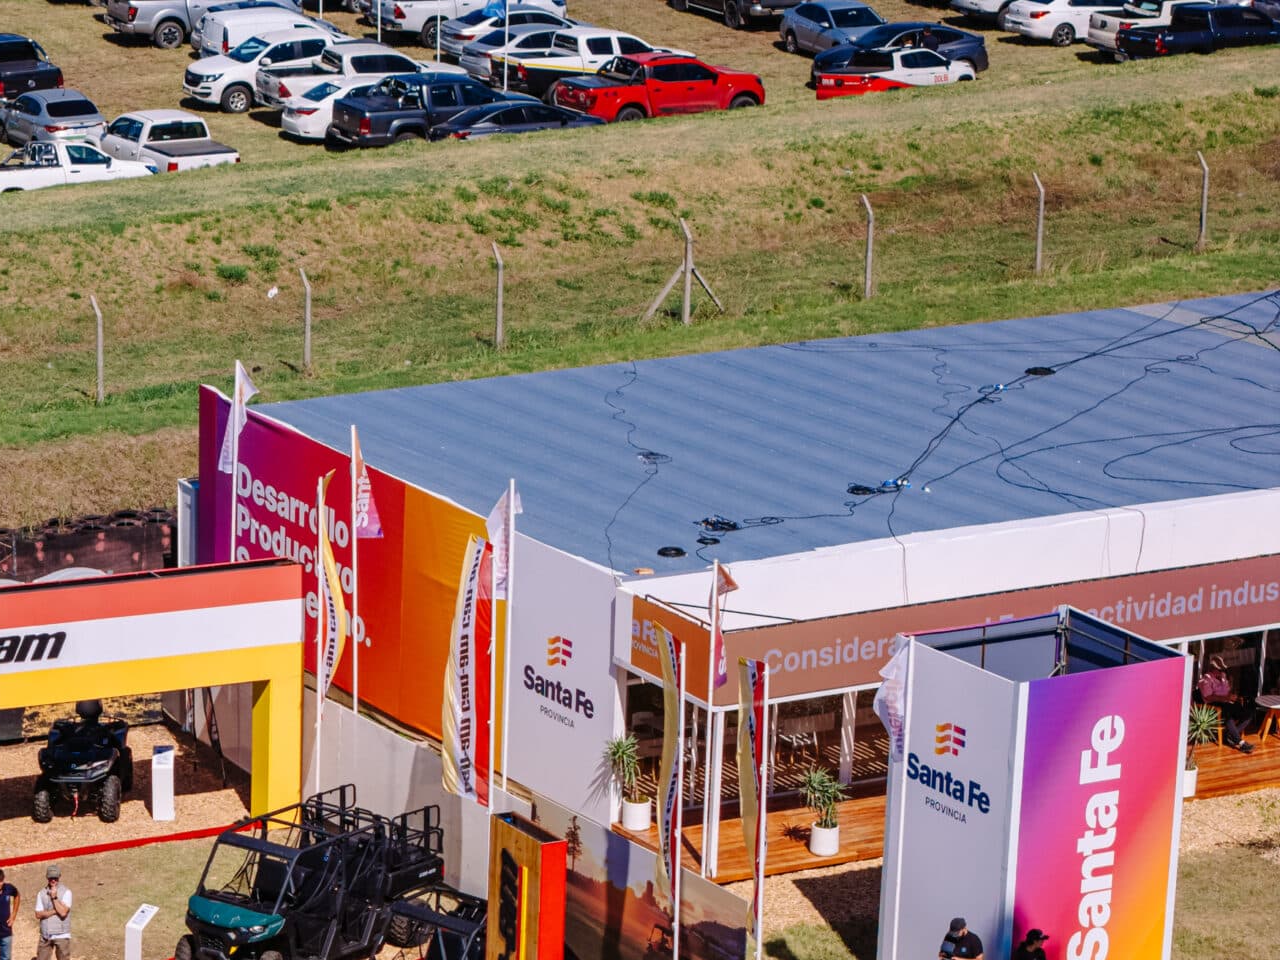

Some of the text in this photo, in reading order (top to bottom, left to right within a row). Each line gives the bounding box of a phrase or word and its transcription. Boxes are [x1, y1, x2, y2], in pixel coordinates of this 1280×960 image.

[523, 665, 594, 719] Santa Fe
[539, 704, 575, 728] PROVINCIA
[1079, 714, 1125, 785] Fe
[907, 752, 990, 814] Santa Fe
[925, 796, 967, 824] PROVINCIA
